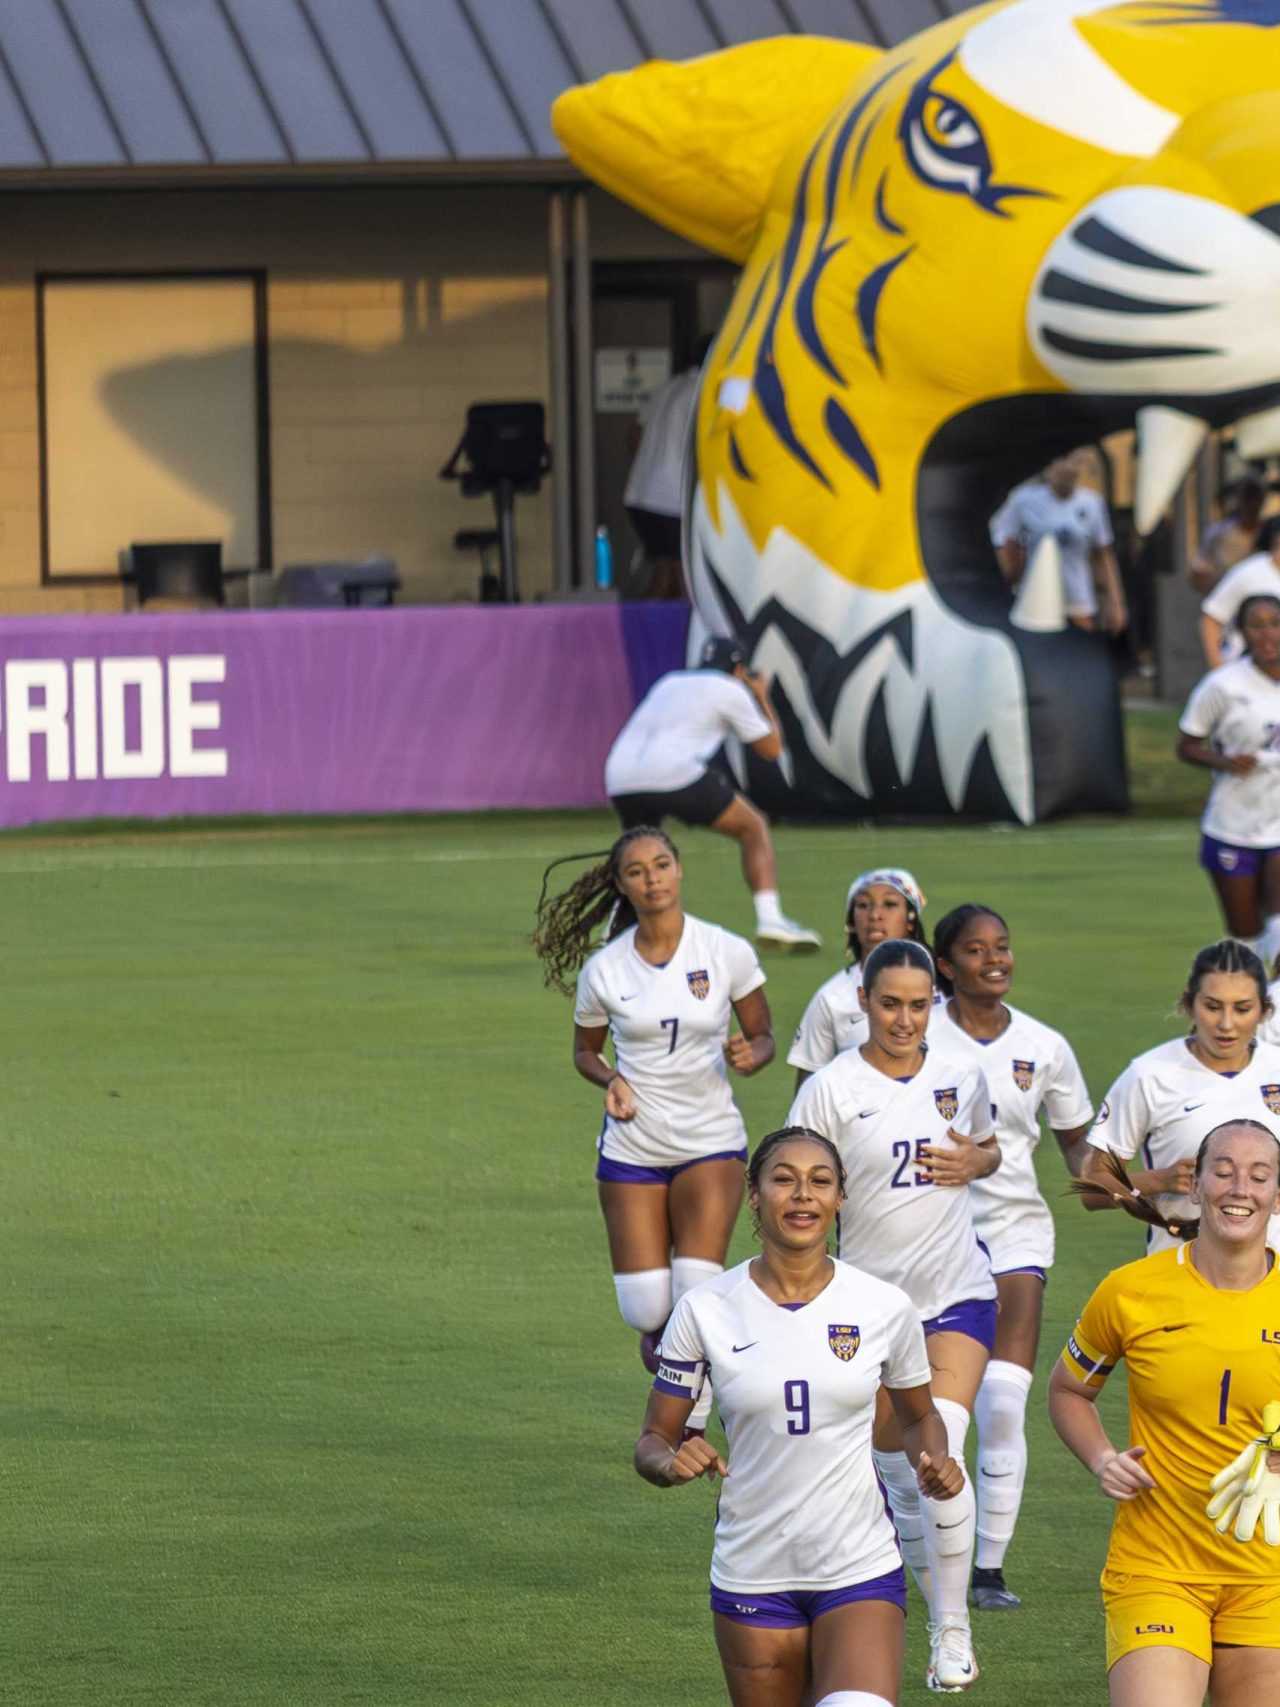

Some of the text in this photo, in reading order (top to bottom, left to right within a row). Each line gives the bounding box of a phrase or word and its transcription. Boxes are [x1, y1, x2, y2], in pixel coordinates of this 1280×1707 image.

[0, 655, 228, 782] RIDE
[660, 1018, 679, 1055] 7
[890, 1138, 934, 1189] 25
[784, 1380, 811, 1435] 9
[1219, 1369, 1232, 1425] 1
[1136, 1625, 1174, 1635] LSU
